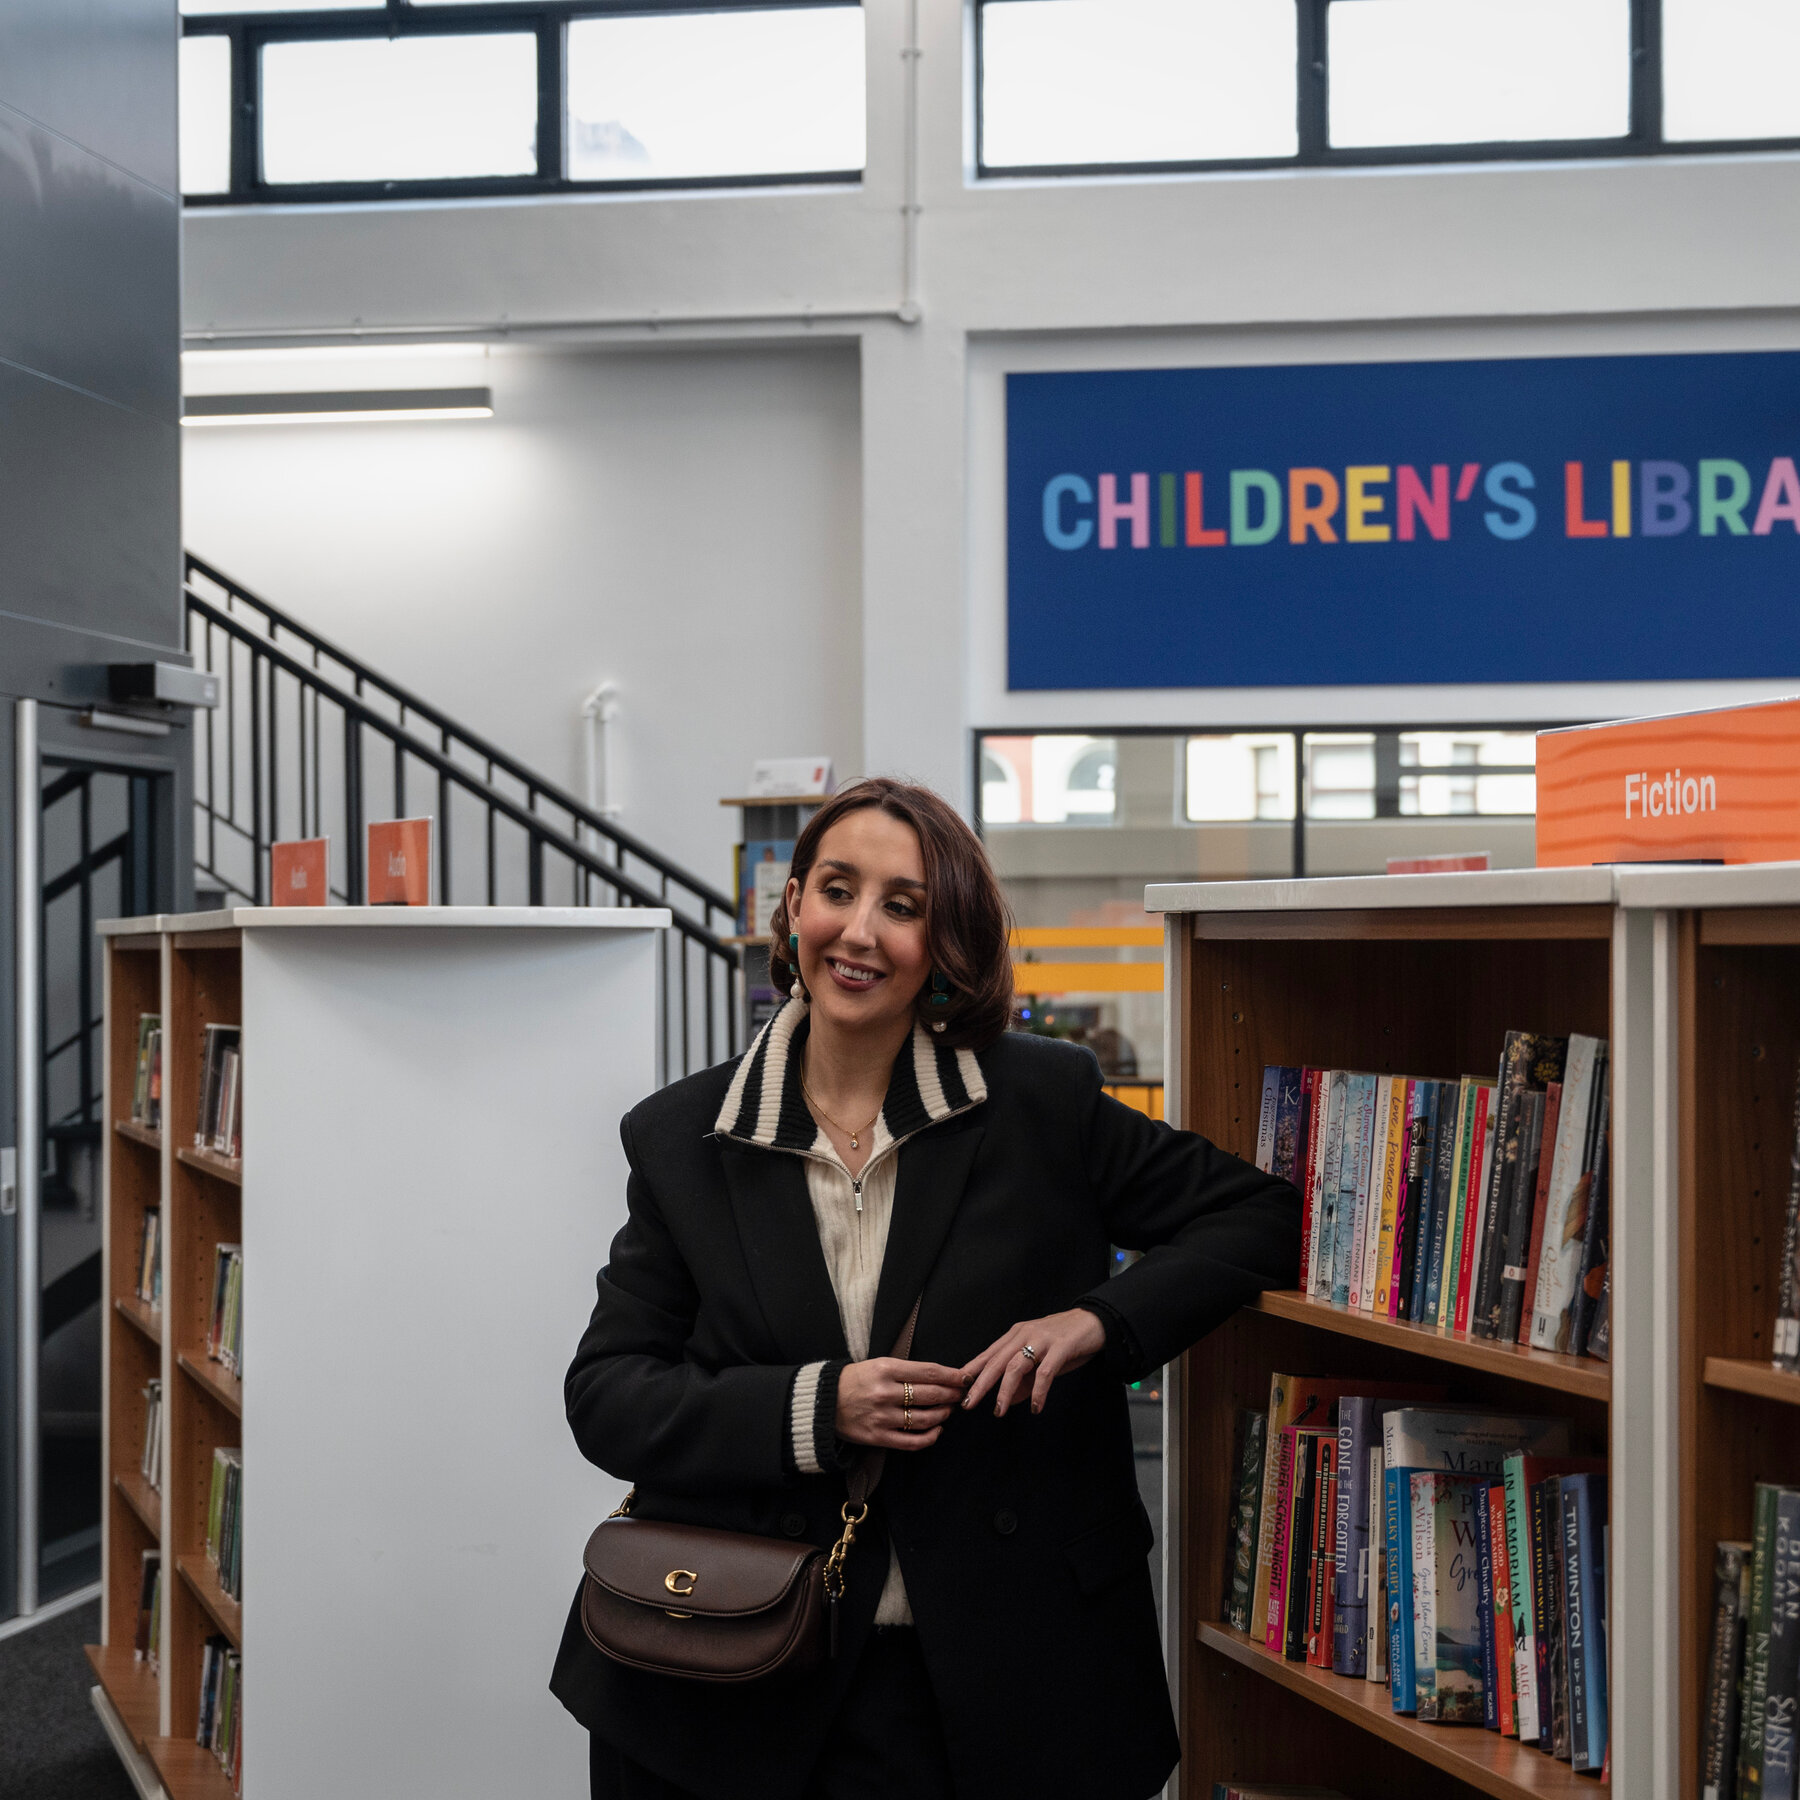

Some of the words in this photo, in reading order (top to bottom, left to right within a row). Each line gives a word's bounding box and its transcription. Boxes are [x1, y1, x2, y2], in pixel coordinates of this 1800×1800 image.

[1042, 461, 1537, 549] CHILDREN'S
[1625, 768, 1717, 820] Fiction
[388, 850, 407, 877] Audio
[1260, 1087, 1273, 1148] Christmas
[1363, 1103, 1373, 1142] Summer
[1379, 1104, 1387, 1137] Unlikely
[1391, 1097, 1402, 1127] Love
[1412, 1094, 1421, 1132] COLM
[1498, 1061, 1513, 1142] BLACKBERRY
[1326, 1121, 1338, 1182] TOWER
[1332, 1108, 1343, 1192] FORGOTTEN
[1389, 1130, 1395, 1138] in
[1424, 1126, 1435, 1168] LILY
[1438, 1139, 1447, 1172] LAKE
[1444, 1128, 1455, 1180] SECRETS
[1495, 1147, 1504, 1161] &
[1360, 1145, 1370, 1187] Getaway
[1385, 1141, 1399, 1201] Provence
[1470, 1160, 1479, 1201] ADVENTURES
[1492, 1163, 1502, 1198] WILD
[1371, 1200, 1379, 1240] Holloway
[1421, 1179, 1429, 1213] ROSE
[1488, 1201, 1498, 1233] ROSE
[1436, 1211, 1444, 1231] LIZ
[1353, 1239, 1361, 1283] TENNANT
[1415, 1220, 1425, 1283] TREMAIN
[1431, 1235, 1442, 1291] TRENOW
[1451, 1228, 1461, 1297] TUOMAINEN
[1545, 1246, 1557, 1308] Question
[1341, 1410, 1352, 1421] THE
[1269, 1433, 1281, 1497] IRVINE
[1278, 1433, 1292, 1488] MURDER
[1338, 1426, 1353, 1476] GONE
[1321, 1463, 1329, 1512] UNDERGROUND
[1387, 1481, 1397, 1496] the
[1504, 1473, 1515, 1491] IN
[1263, 1504, 1276, 1566] WELSH
[1273, 1497, 1287, 1548] SCHOOL
[1319, 1514, 1327, 1548] RAILROAD
[1336, 1494, 1350, 1573] FORGOTTEN
[1388, 1500, 1398, 1542] LUCKY
[1415, 1507, 1425, 1560] Wilson
[1477, 1487, 1488, 1540] Daughters
[1535, 1508, 1543, 1542] LAST
[1566, 1506, 1577, 1547] TIM
[1270, 1549, 1284, 1590] NIGHT
[1389, 1546, 1400, 1595] ESCAPE
[1482, 1542, 1488, 1554] of
[1506, 1500, 1521, 1607] MEMORIAM
[1417, 1568, 1431, 1597] Greek
[1481, 1557, 1491, 1606] Chivalry
[1536, 1548, 1545, 1632] HOUSEWIFE
[1548, 1574, 1556, 1622] Shankly
[1751, 1551, 1766, 1616] KLUNE
[1771, 1515, 1789, 1637] KOONTZ
[1785, 1540, 1800, 1619] DEAN
[1314, 1585, 1322, 1626] WHITEHEAD
[1420, 1600, 1431, 1629] Island
[1567, 1554, 1582, 1648] WINTON
[1419, 1631, 1431, 1664] Escape
[1755, 1632, 1769, 1656] IN
[1519, 1664, 1530, 1698] ALICE
[1572, 1658, 1583, 1724] EYRIE
[1752, 1662, 1769, 1696] THE
[1712, 1678, 1729, 1788] KIRKPATRICK
[1749, 1700, 1766, 1751] LIVES
[1777, 1694, 1798, 1775] SAINT
